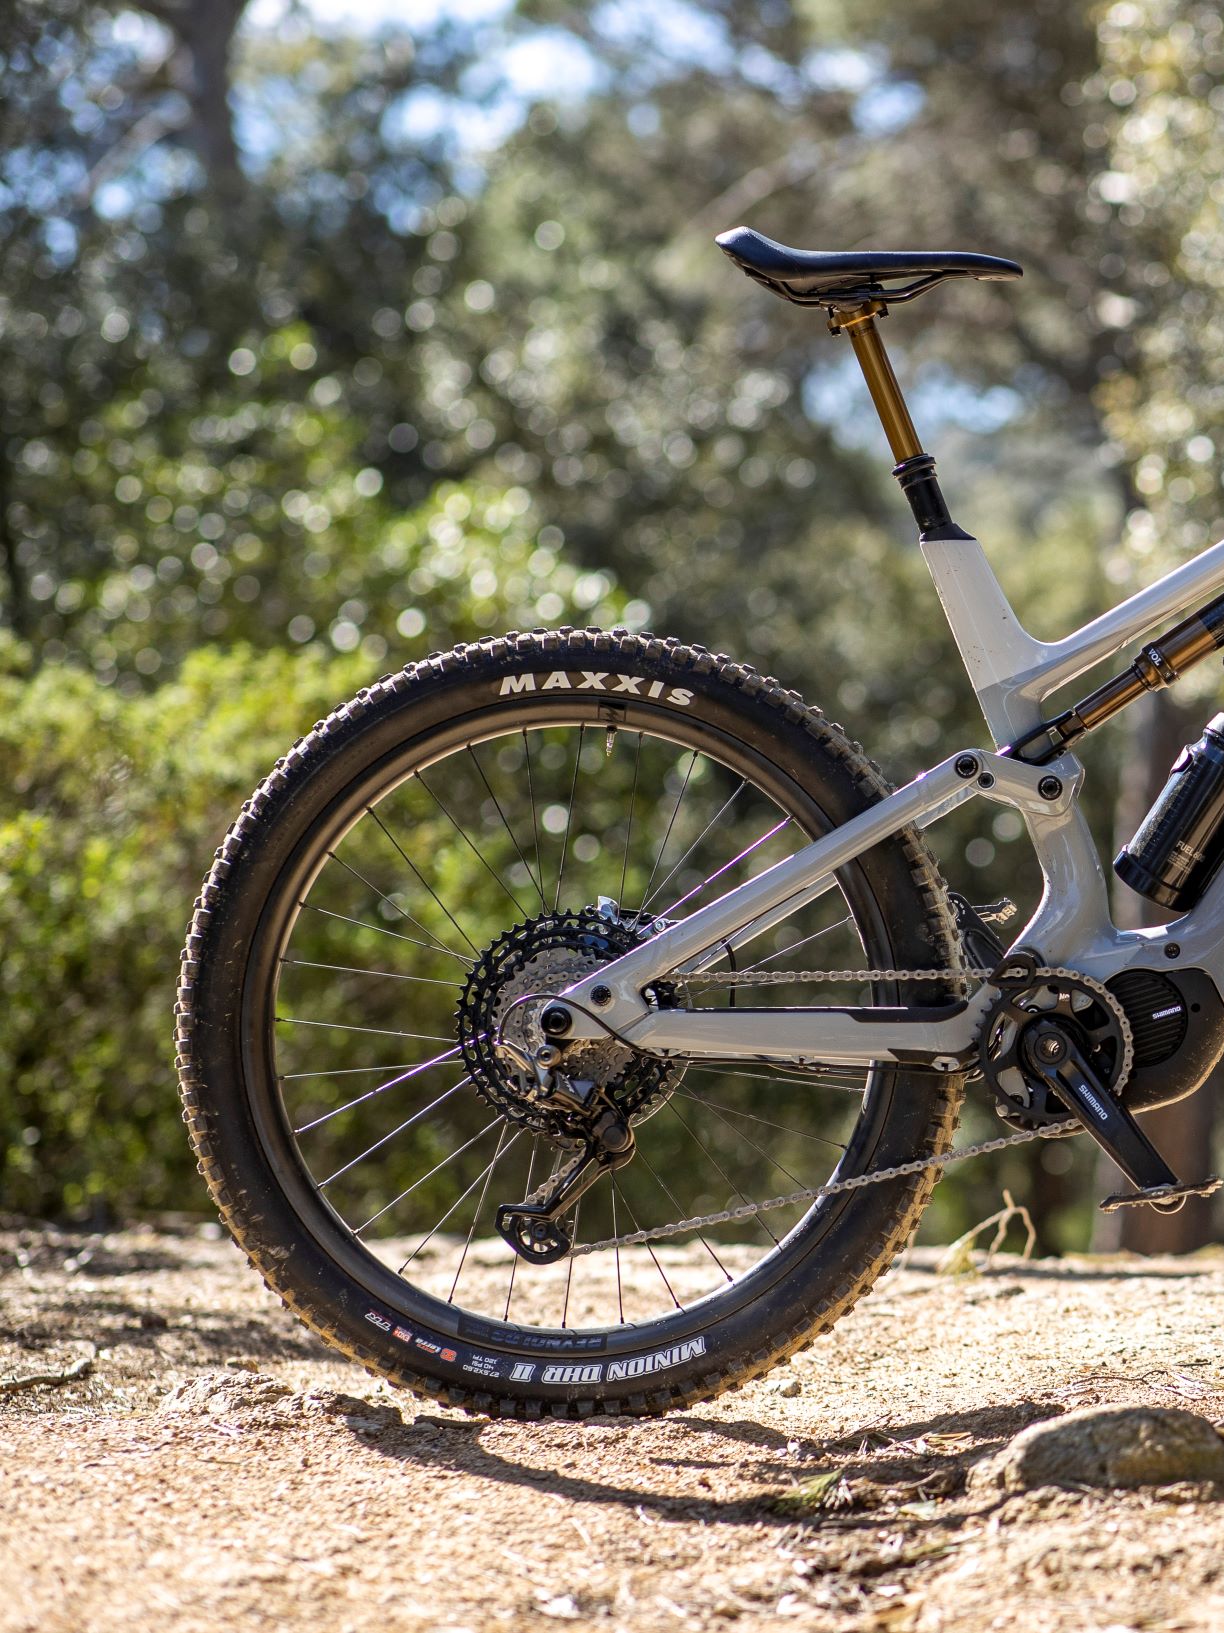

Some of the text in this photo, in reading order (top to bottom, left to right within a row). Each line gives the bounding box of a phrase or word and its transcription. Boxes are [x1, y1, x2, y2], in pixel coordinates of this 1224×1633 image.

[499, 671, 695, 706] MAXXIS
[1175, 840, 1195, 856] FUEL
[1152, 1005, 1182, 1020] SHIMANO
[1078, 1084, 1108, 1121] SHIMANO
[364, 1312, 392, 1332] TR
[440, 1347, 457, 1362] 3C
[510, 1336, 706, 1384] MINION DHR II
